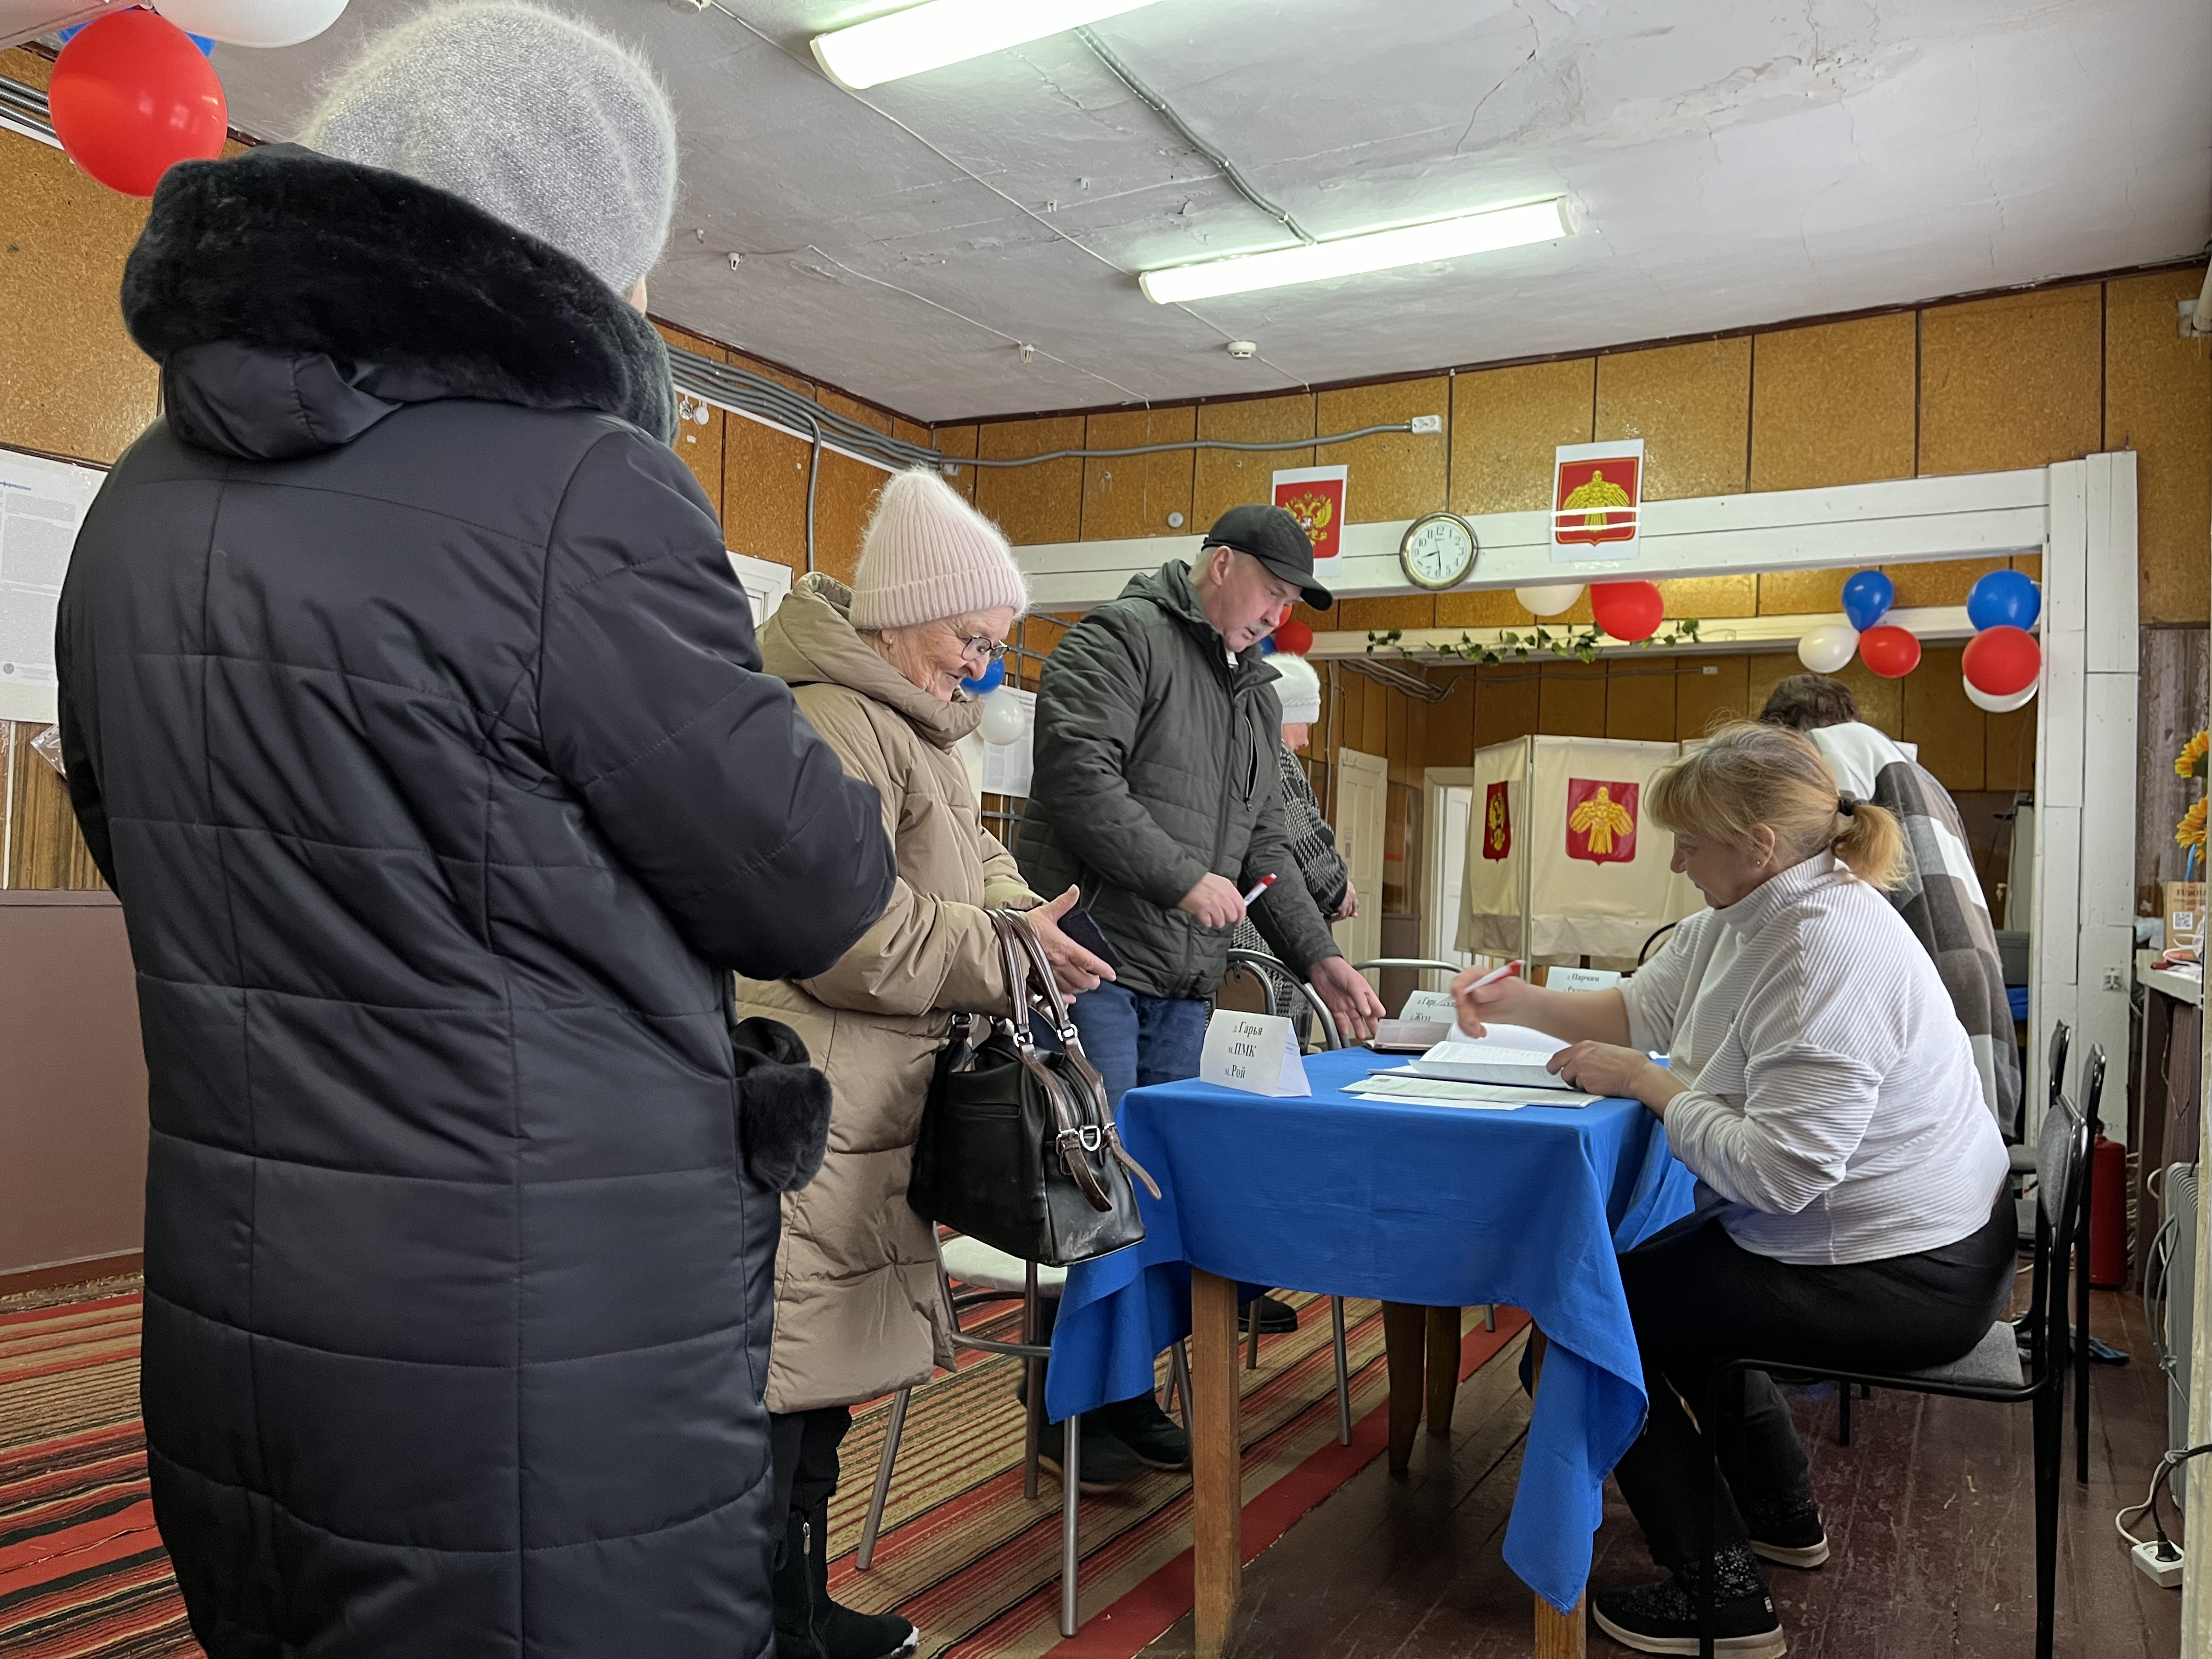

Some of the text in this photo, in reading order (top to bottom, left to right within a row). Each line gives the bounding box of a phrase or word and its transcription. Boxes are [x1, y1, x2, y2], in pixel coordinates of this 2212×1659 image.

[1427, 529, 1433, 539] 11
[1436, 525, 1444, 535] 12
[1419, 538, 1427, 547] 10
[1454, 536, 1461, 545] 2
[1231, 1064, 1246, 1079] Рой
